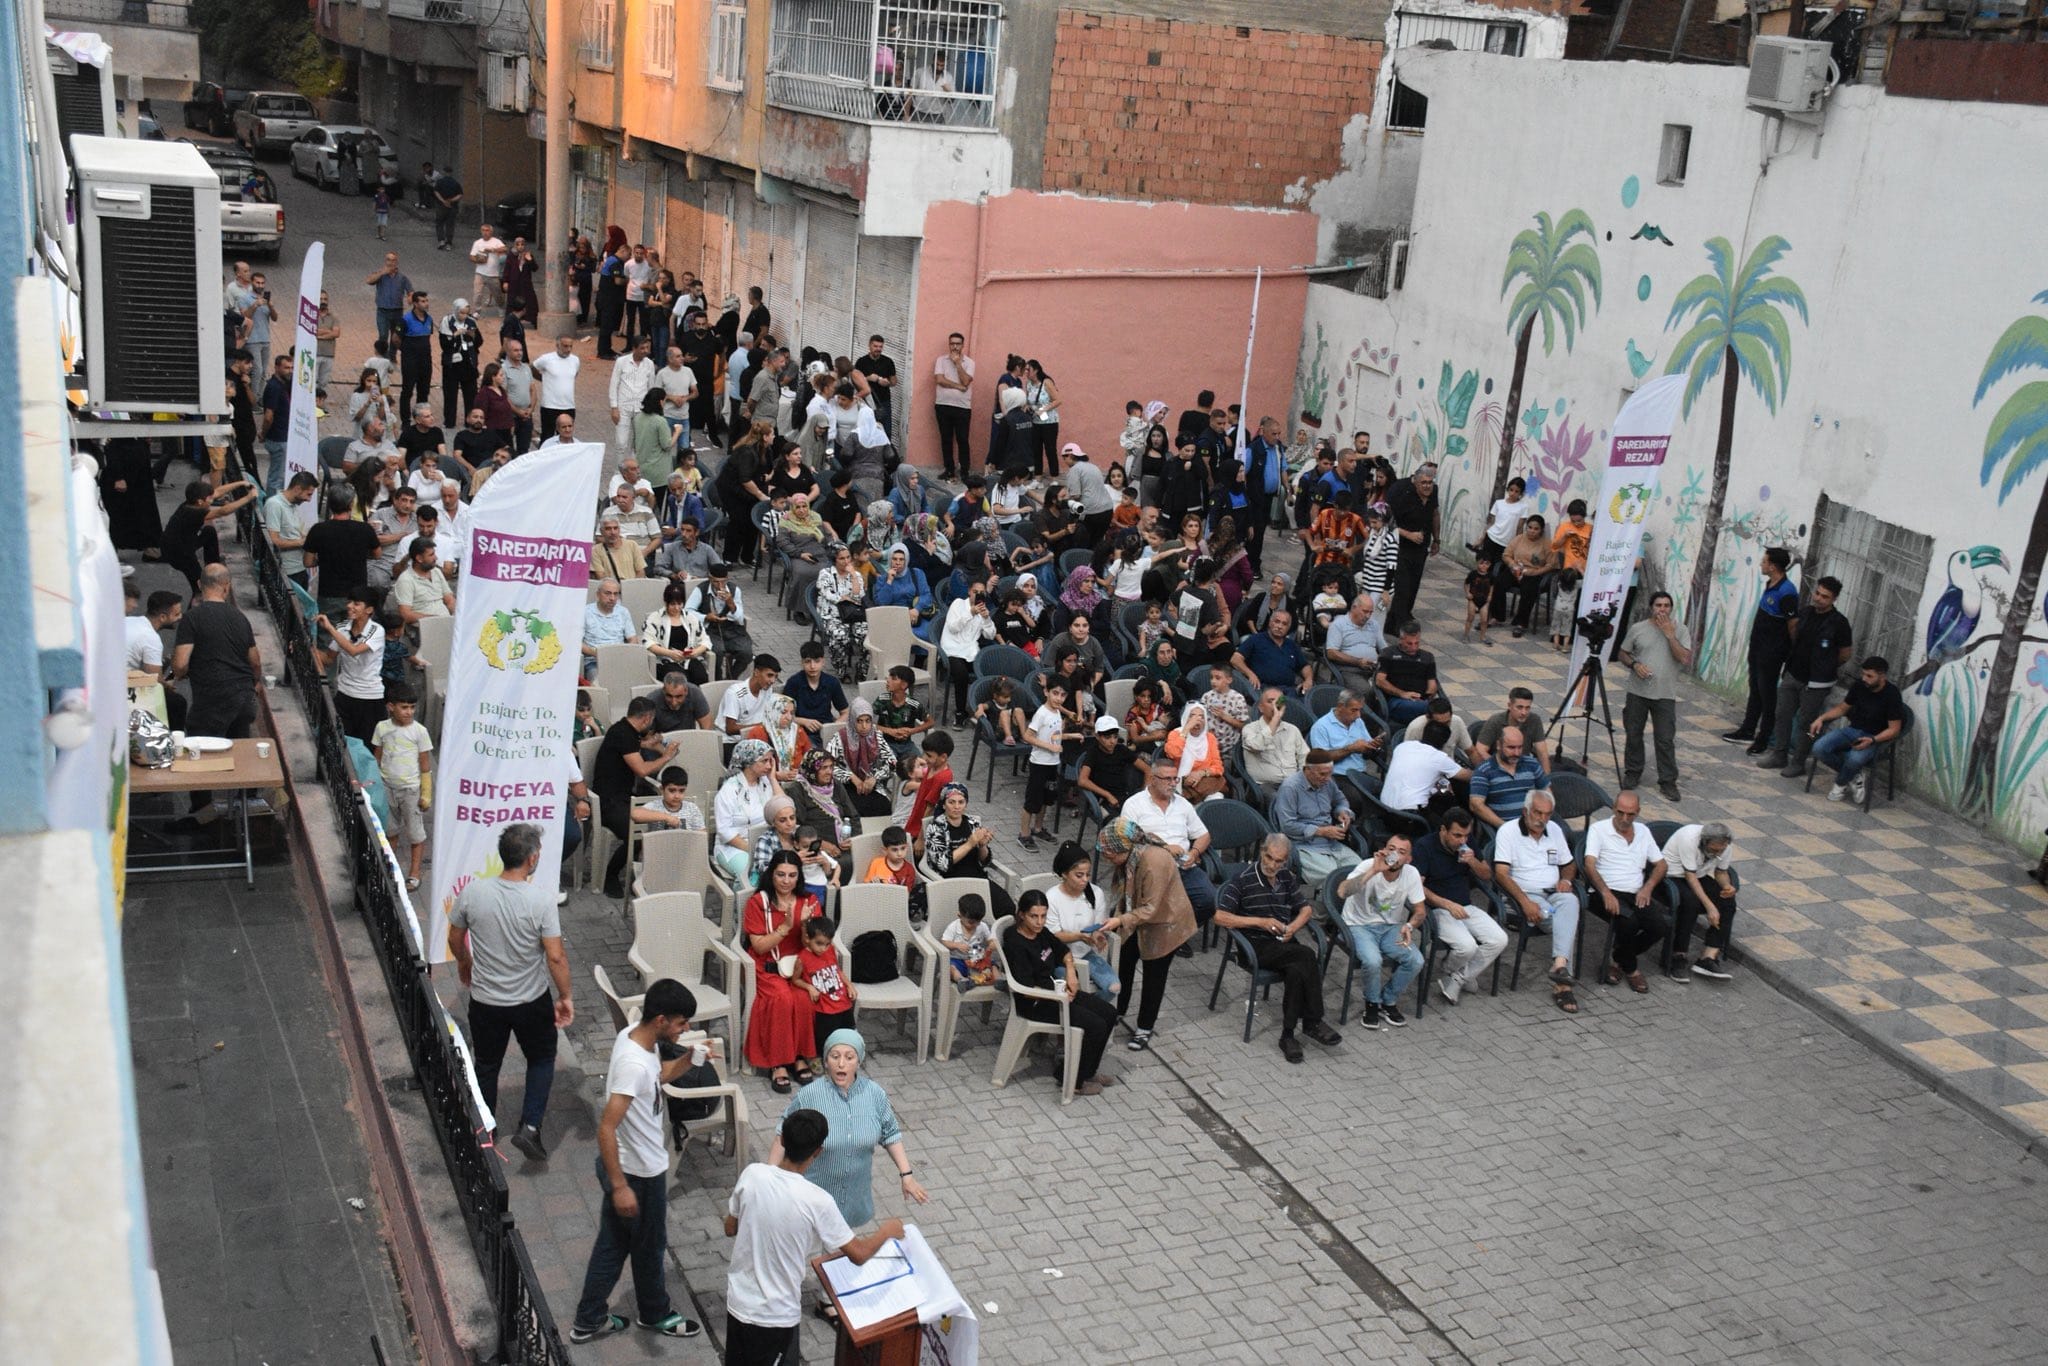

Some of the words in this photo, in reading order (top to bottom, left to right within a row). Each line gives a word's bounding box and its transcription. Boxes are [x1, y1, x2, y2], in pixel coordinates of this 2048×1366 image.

[497, 562, 564, 584] REZANÎ
[479, 702, 528, 720] Bajarê
[471, 721, 533, 743] Butçeya
[459, 778, 556, 801] BUTÇEYA
[456, 804, 555, 827] BEŞDARE
